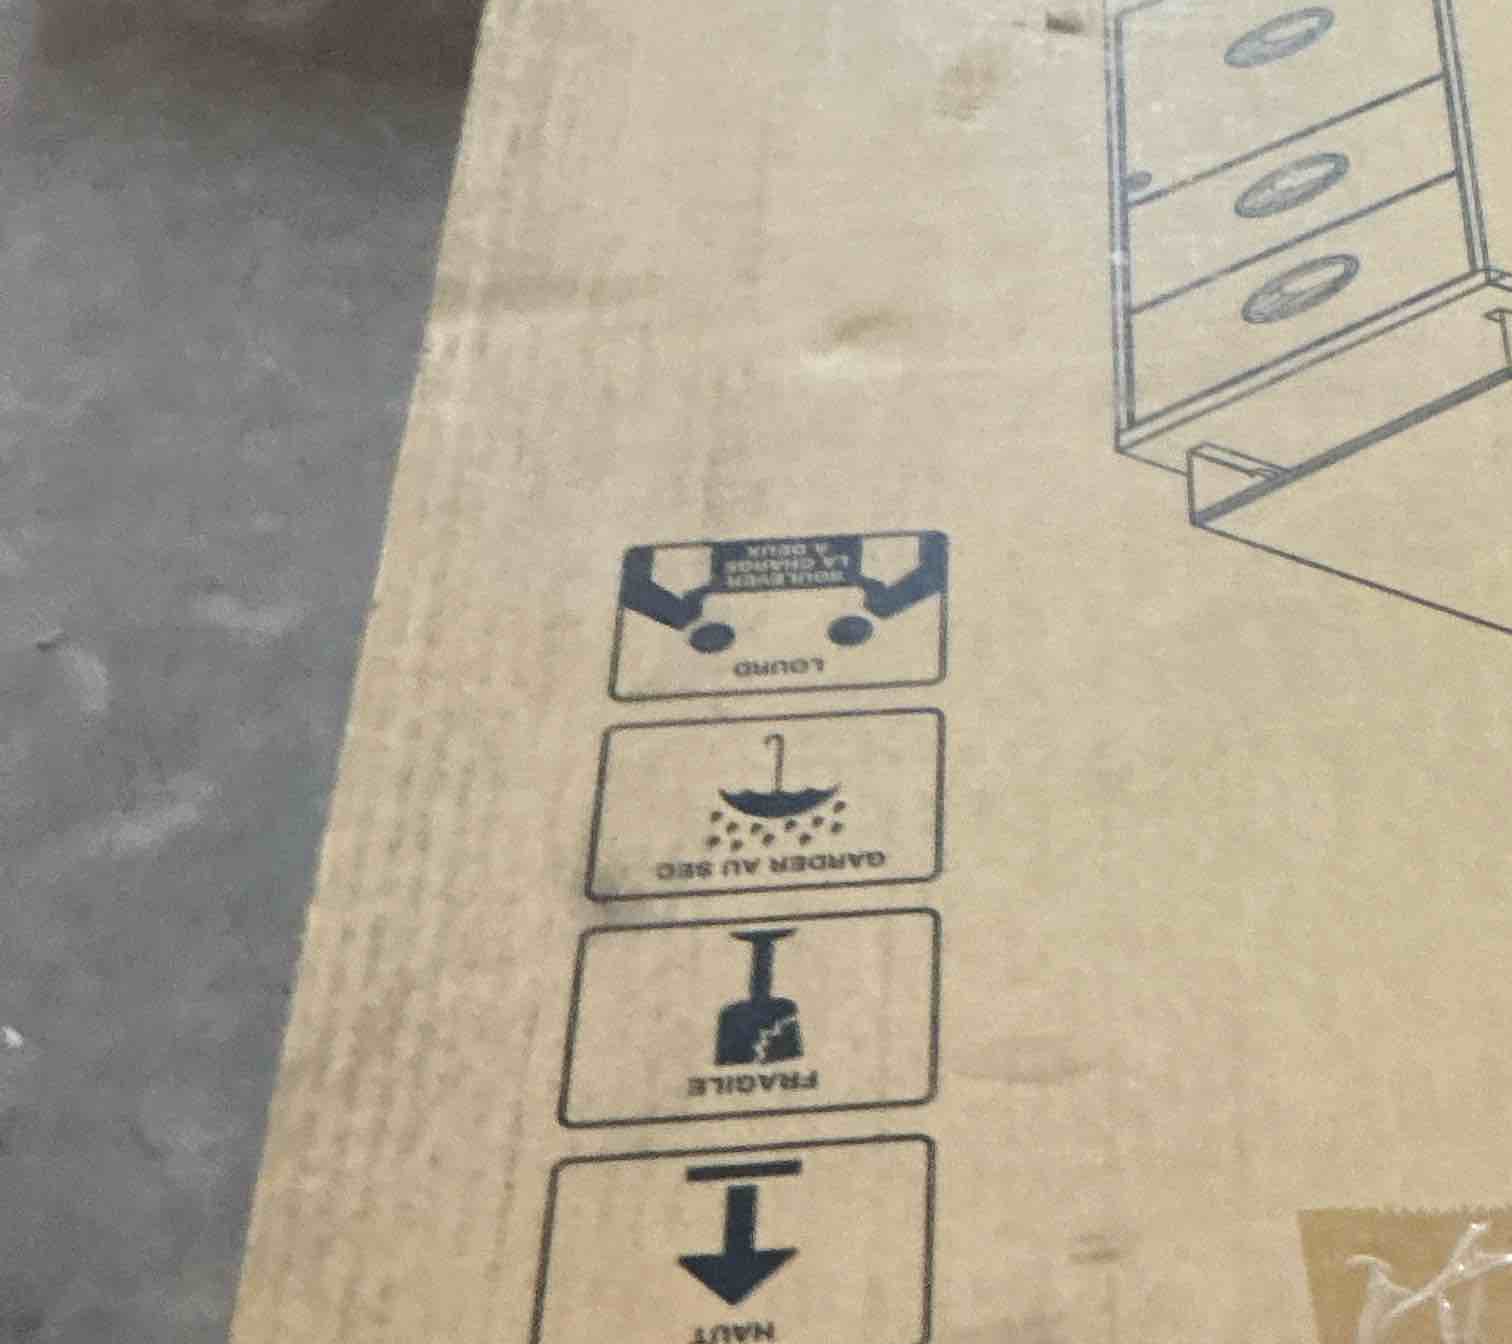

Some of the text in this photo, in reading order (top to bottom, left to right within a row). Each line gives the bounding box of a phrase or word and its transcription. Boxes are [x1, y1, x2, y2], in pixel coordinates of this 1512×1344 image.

[733, 658, 825, 678] LOURD
[655, 850, 886, 881] GARDER AU SEC
[687, 1071, 820, 1095] FRAGILE
